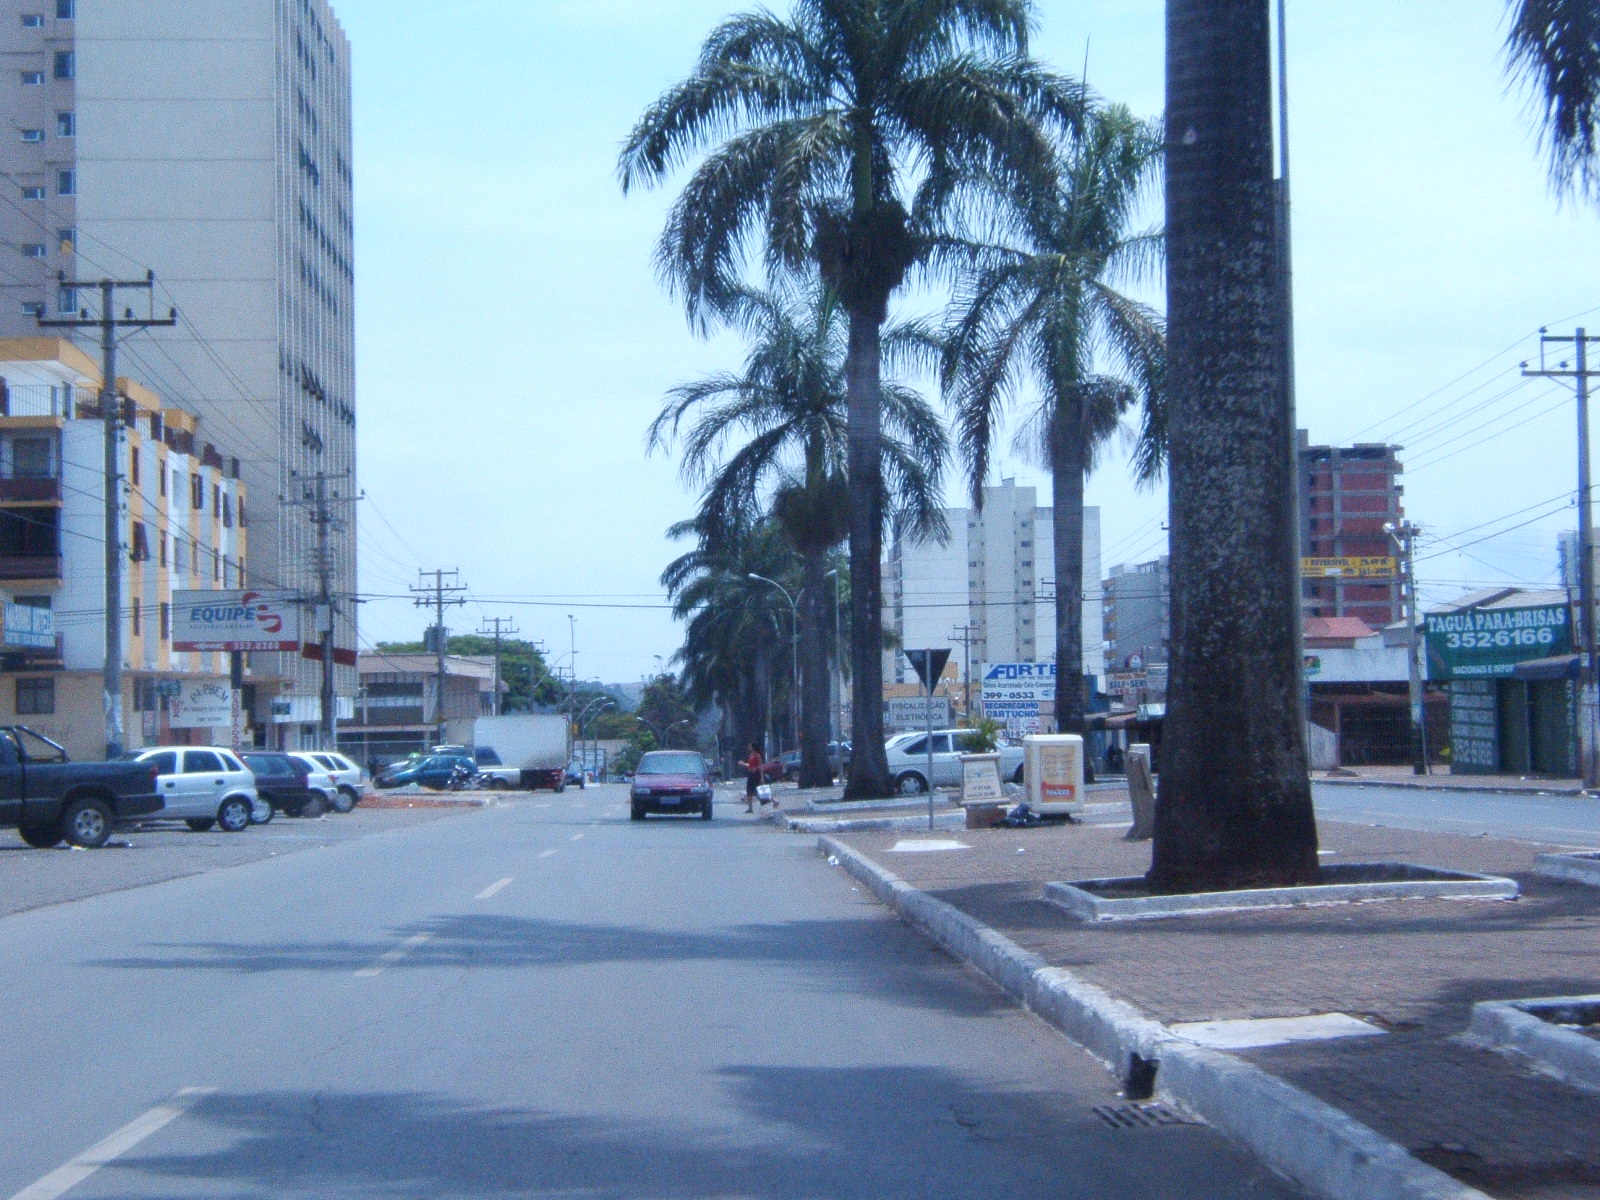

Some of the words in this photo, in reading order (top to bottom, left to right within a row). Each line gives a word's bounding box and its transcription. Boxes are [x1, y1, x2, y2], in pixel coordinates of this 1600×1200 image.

[190, 607, 256, 623] EQUIPE
[1426, 611, 1474, 633] TAGUÁ
[1475, 607, 1565, 630] PARA-BRISAS
[1446, 627, 1554, 648] 352-6166
[984, 663, 1056, 680] FORTE
[891, 701, 946, 709] FISCALIZÇÃO
[896, 712, 943, 720] ELETRÔNCA
